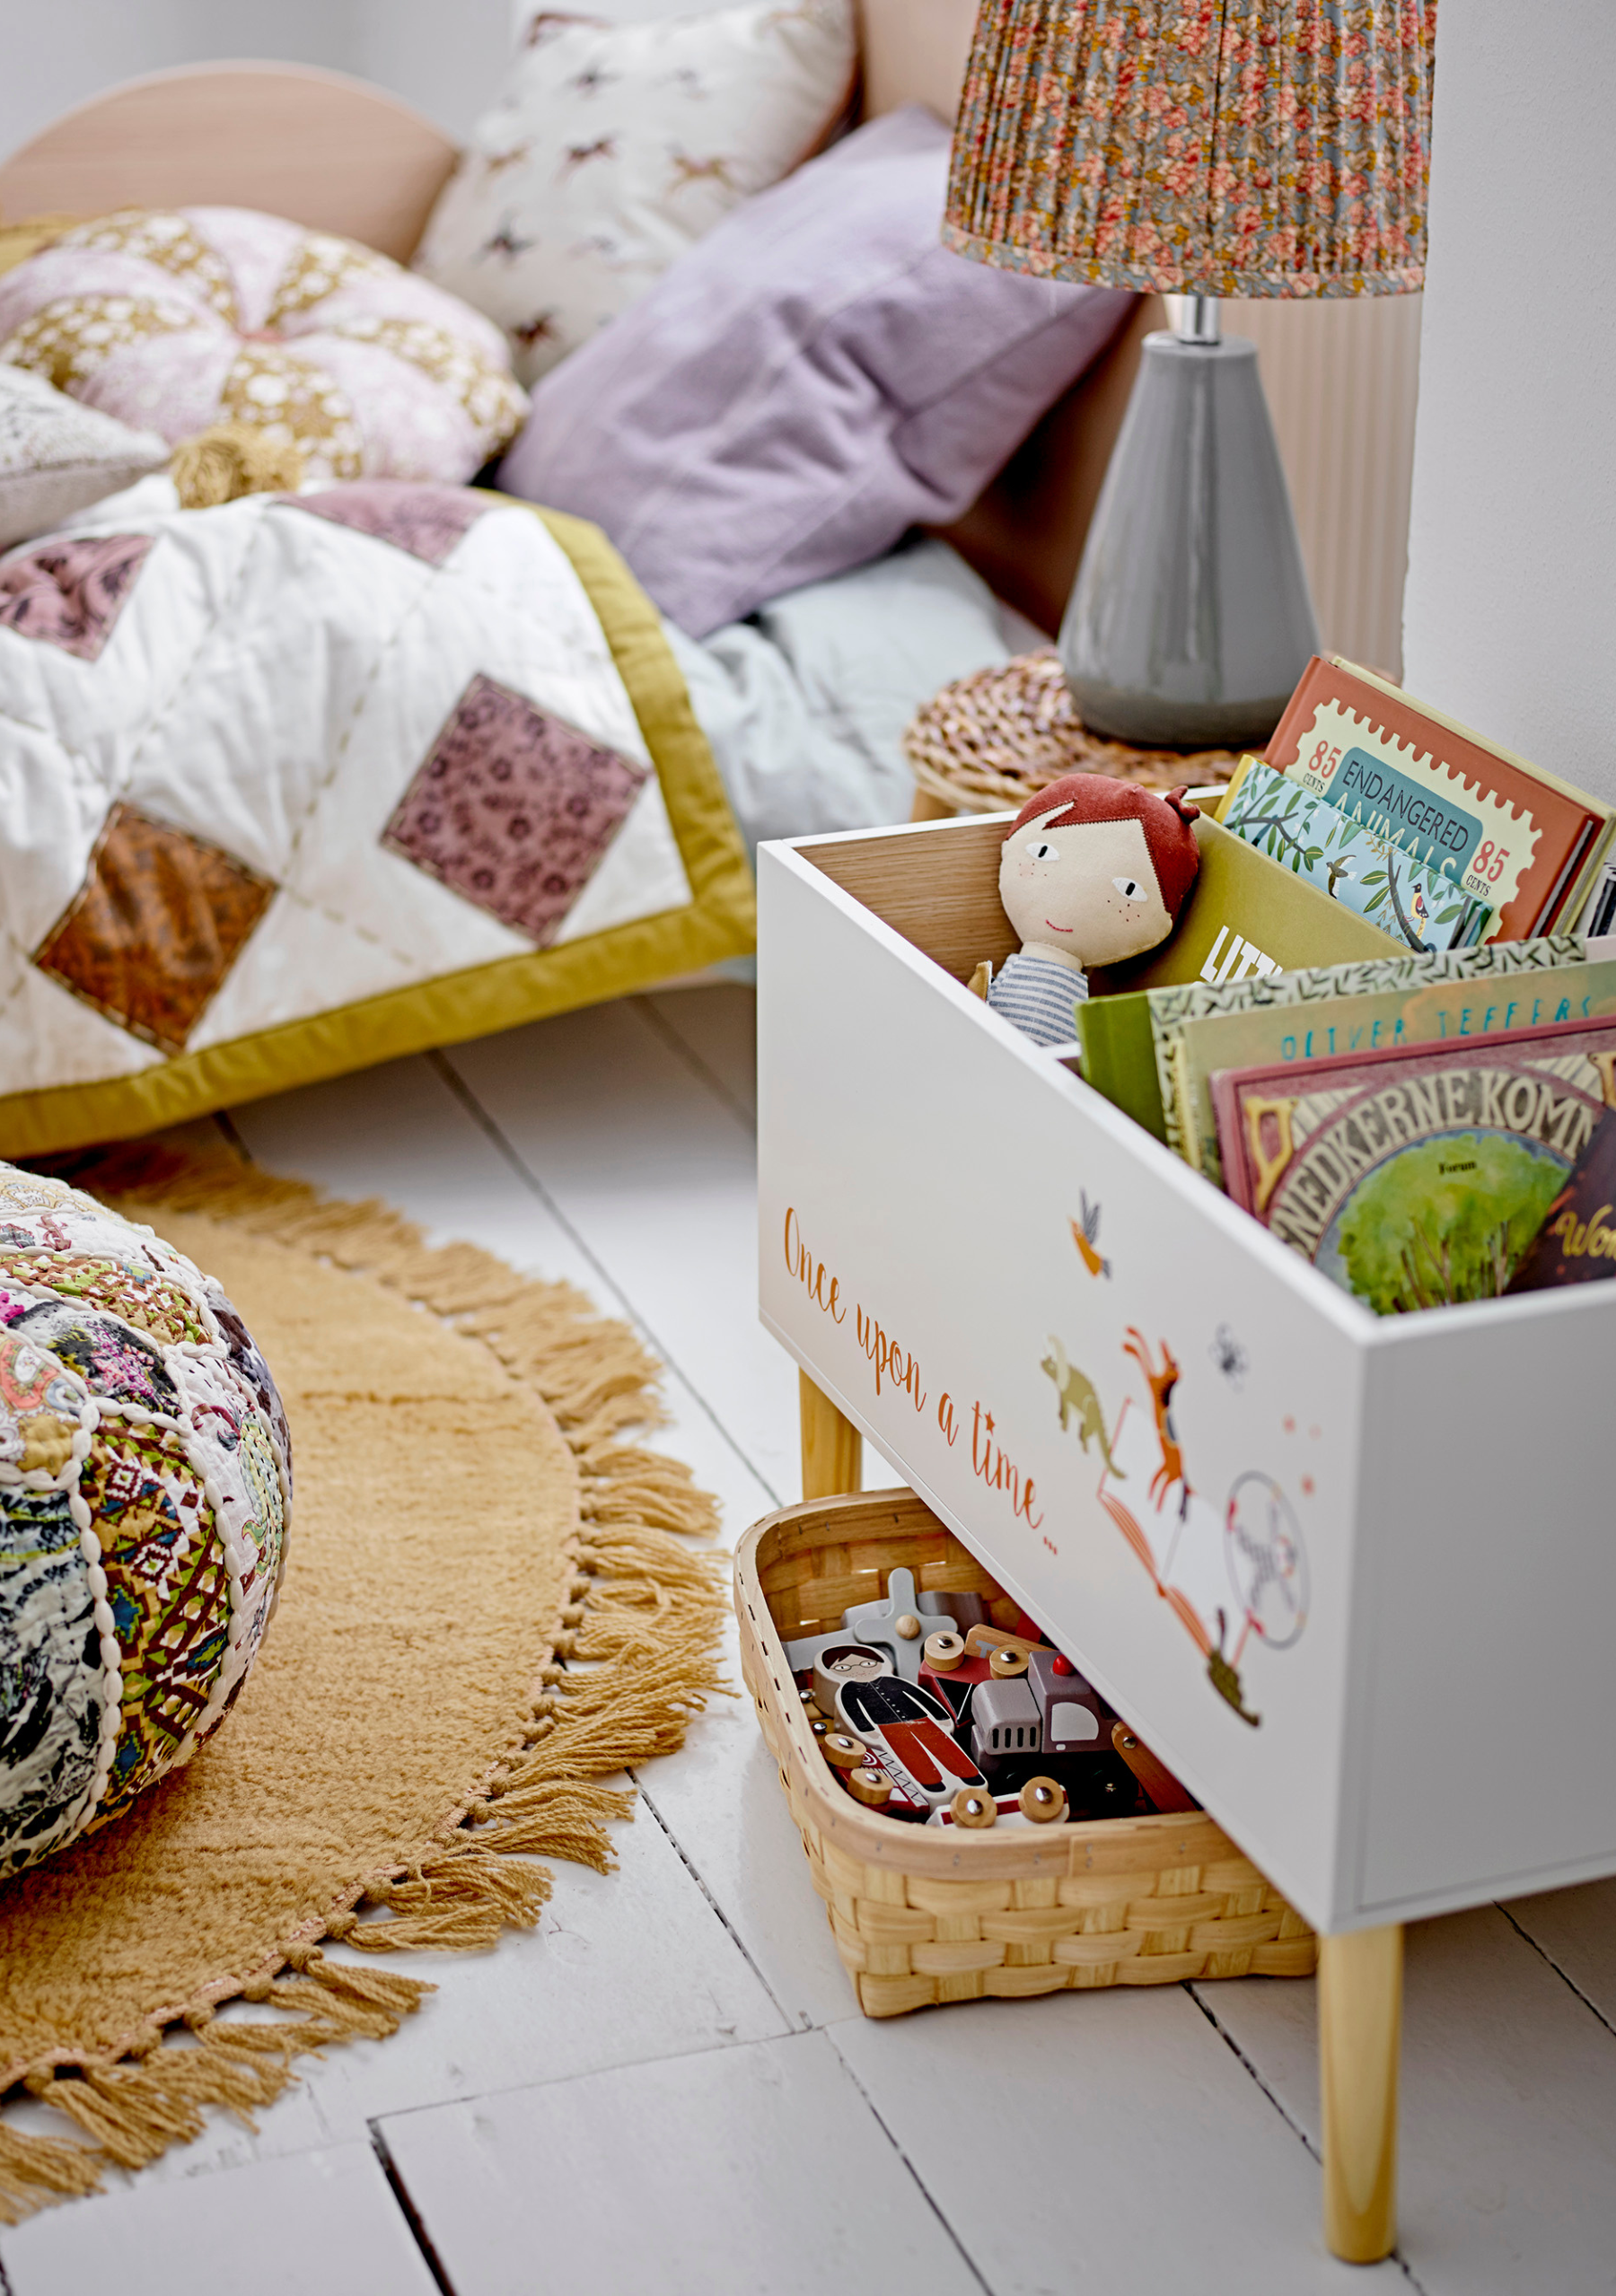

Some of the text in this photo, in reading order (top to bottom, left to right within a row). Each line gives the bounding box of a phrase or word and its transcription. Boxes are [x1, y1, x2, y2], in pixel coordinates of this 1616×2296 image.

[1308, 741, 1342, 778] 85
[1303, 773, 1326, 793] CENTS
[1342, 759, 1469, 852] ENDANGERED
[1472, 840, 1510, 882] 85
[1466, 874, 1491, 896] CENTS
[1199, 925, 1283, 986] LITT
[785, 1207, 847, 1324] Once
[856, 1303, 927, 1413] upon
[938, 1392, 959, 1447] a
